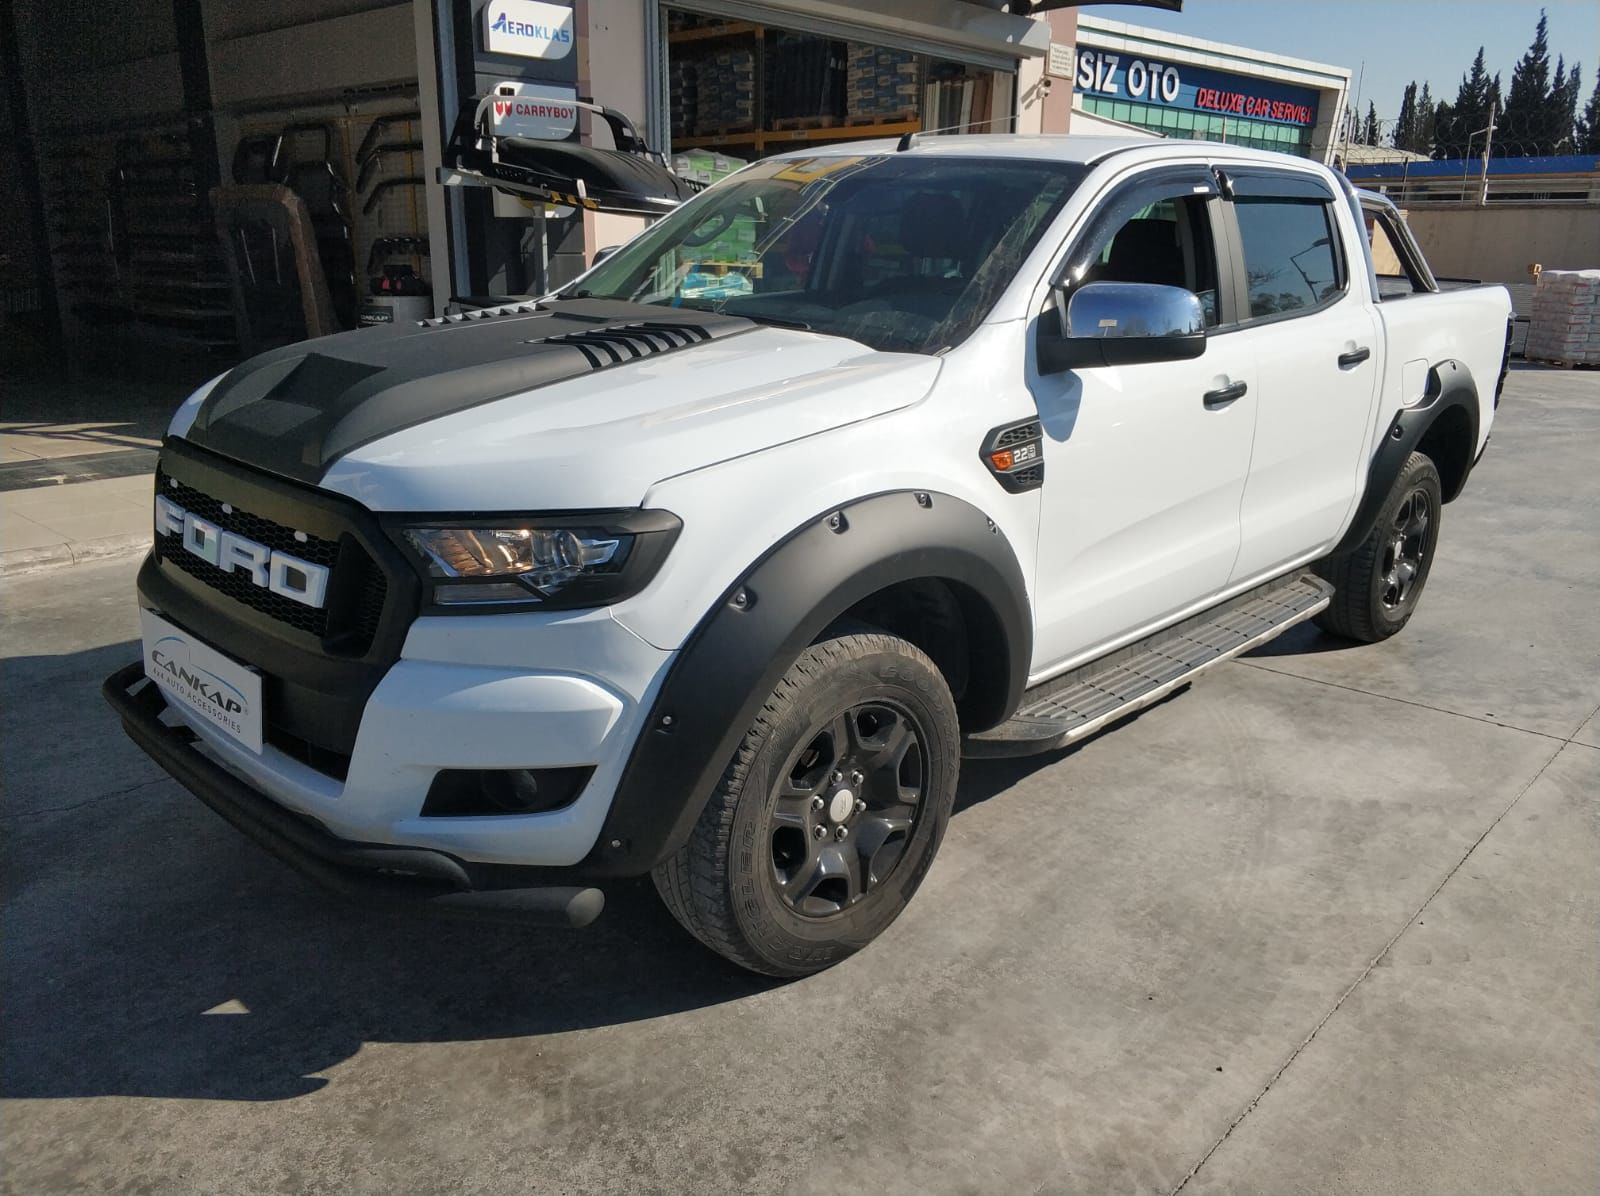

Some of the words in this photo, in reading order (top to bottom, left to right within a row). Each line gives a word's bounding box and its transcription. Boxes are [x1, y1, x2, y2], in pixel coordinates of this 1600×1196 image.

[490, 12, 570, 43] AEROKLAS
[1128, 60, 1179, 102] OTO
[1197, 87, 1245, 113] DELUXE
[1246, 96, 1270, 114] CAR
[516, 103, 575, 119] CARRYBOY
[156, 494, 330, 609] FORD
[152, 650, 242, 714] CANKAP
[166, 678, 185, 695] AUTO
[187, 692, 241, 735] ACCESSORIES
